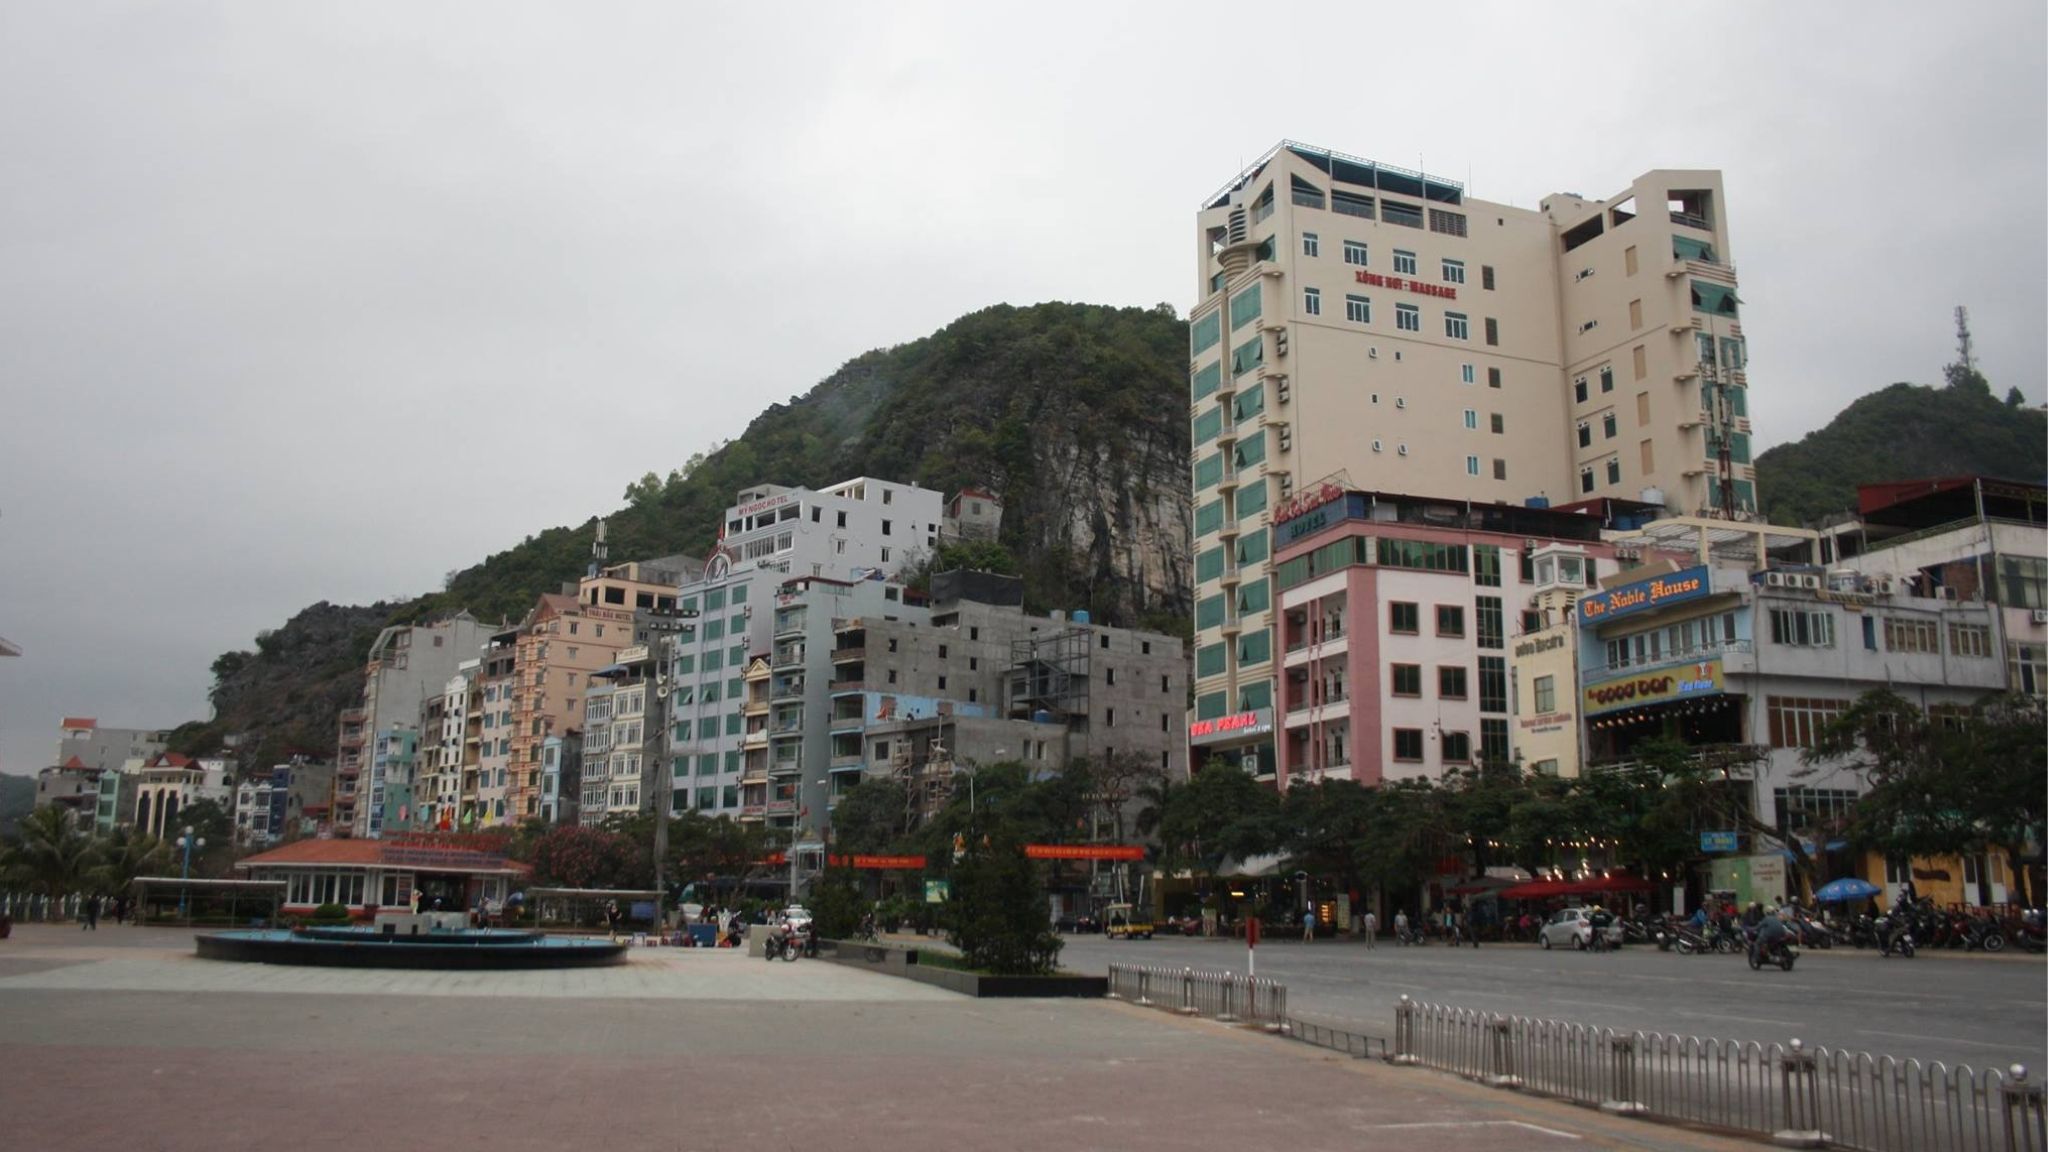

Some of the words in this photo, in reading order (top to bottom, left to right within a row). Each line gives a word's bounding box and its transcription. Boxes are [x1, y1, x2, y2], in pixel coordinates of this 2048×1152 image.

[1409, 280, 1457, 300] MASSAGE
[1584, 600, 1606, 618] The
[1609, 588, 1646, 615] Noble
[1650, 577, 1700, 605] House
[1190, 720, 1213, 737] SEA
[1217, 711, 1257, 731] PEARL
